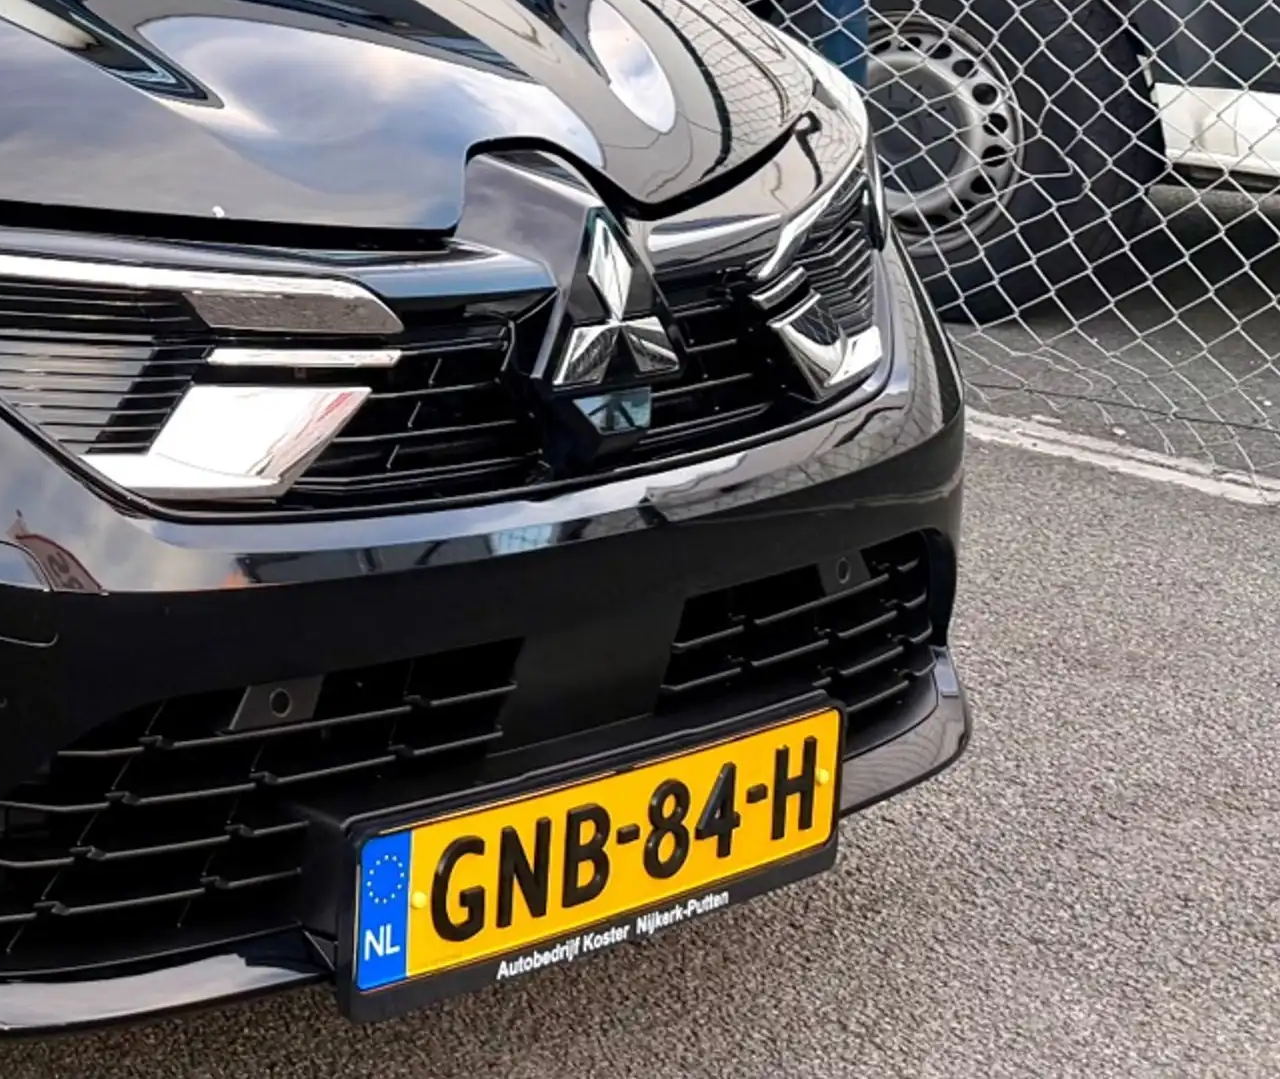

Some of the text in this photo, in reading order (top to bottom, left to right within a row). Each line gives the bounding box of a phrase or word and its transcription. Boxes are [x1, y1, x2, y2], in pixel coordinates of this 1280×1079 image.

[430, 735, 818, 943] GNB-84-H
[364, 923, 401, 962] NL
[496, 889, 730, 981] Autobedrijf Koster Nijkerk-Putten
